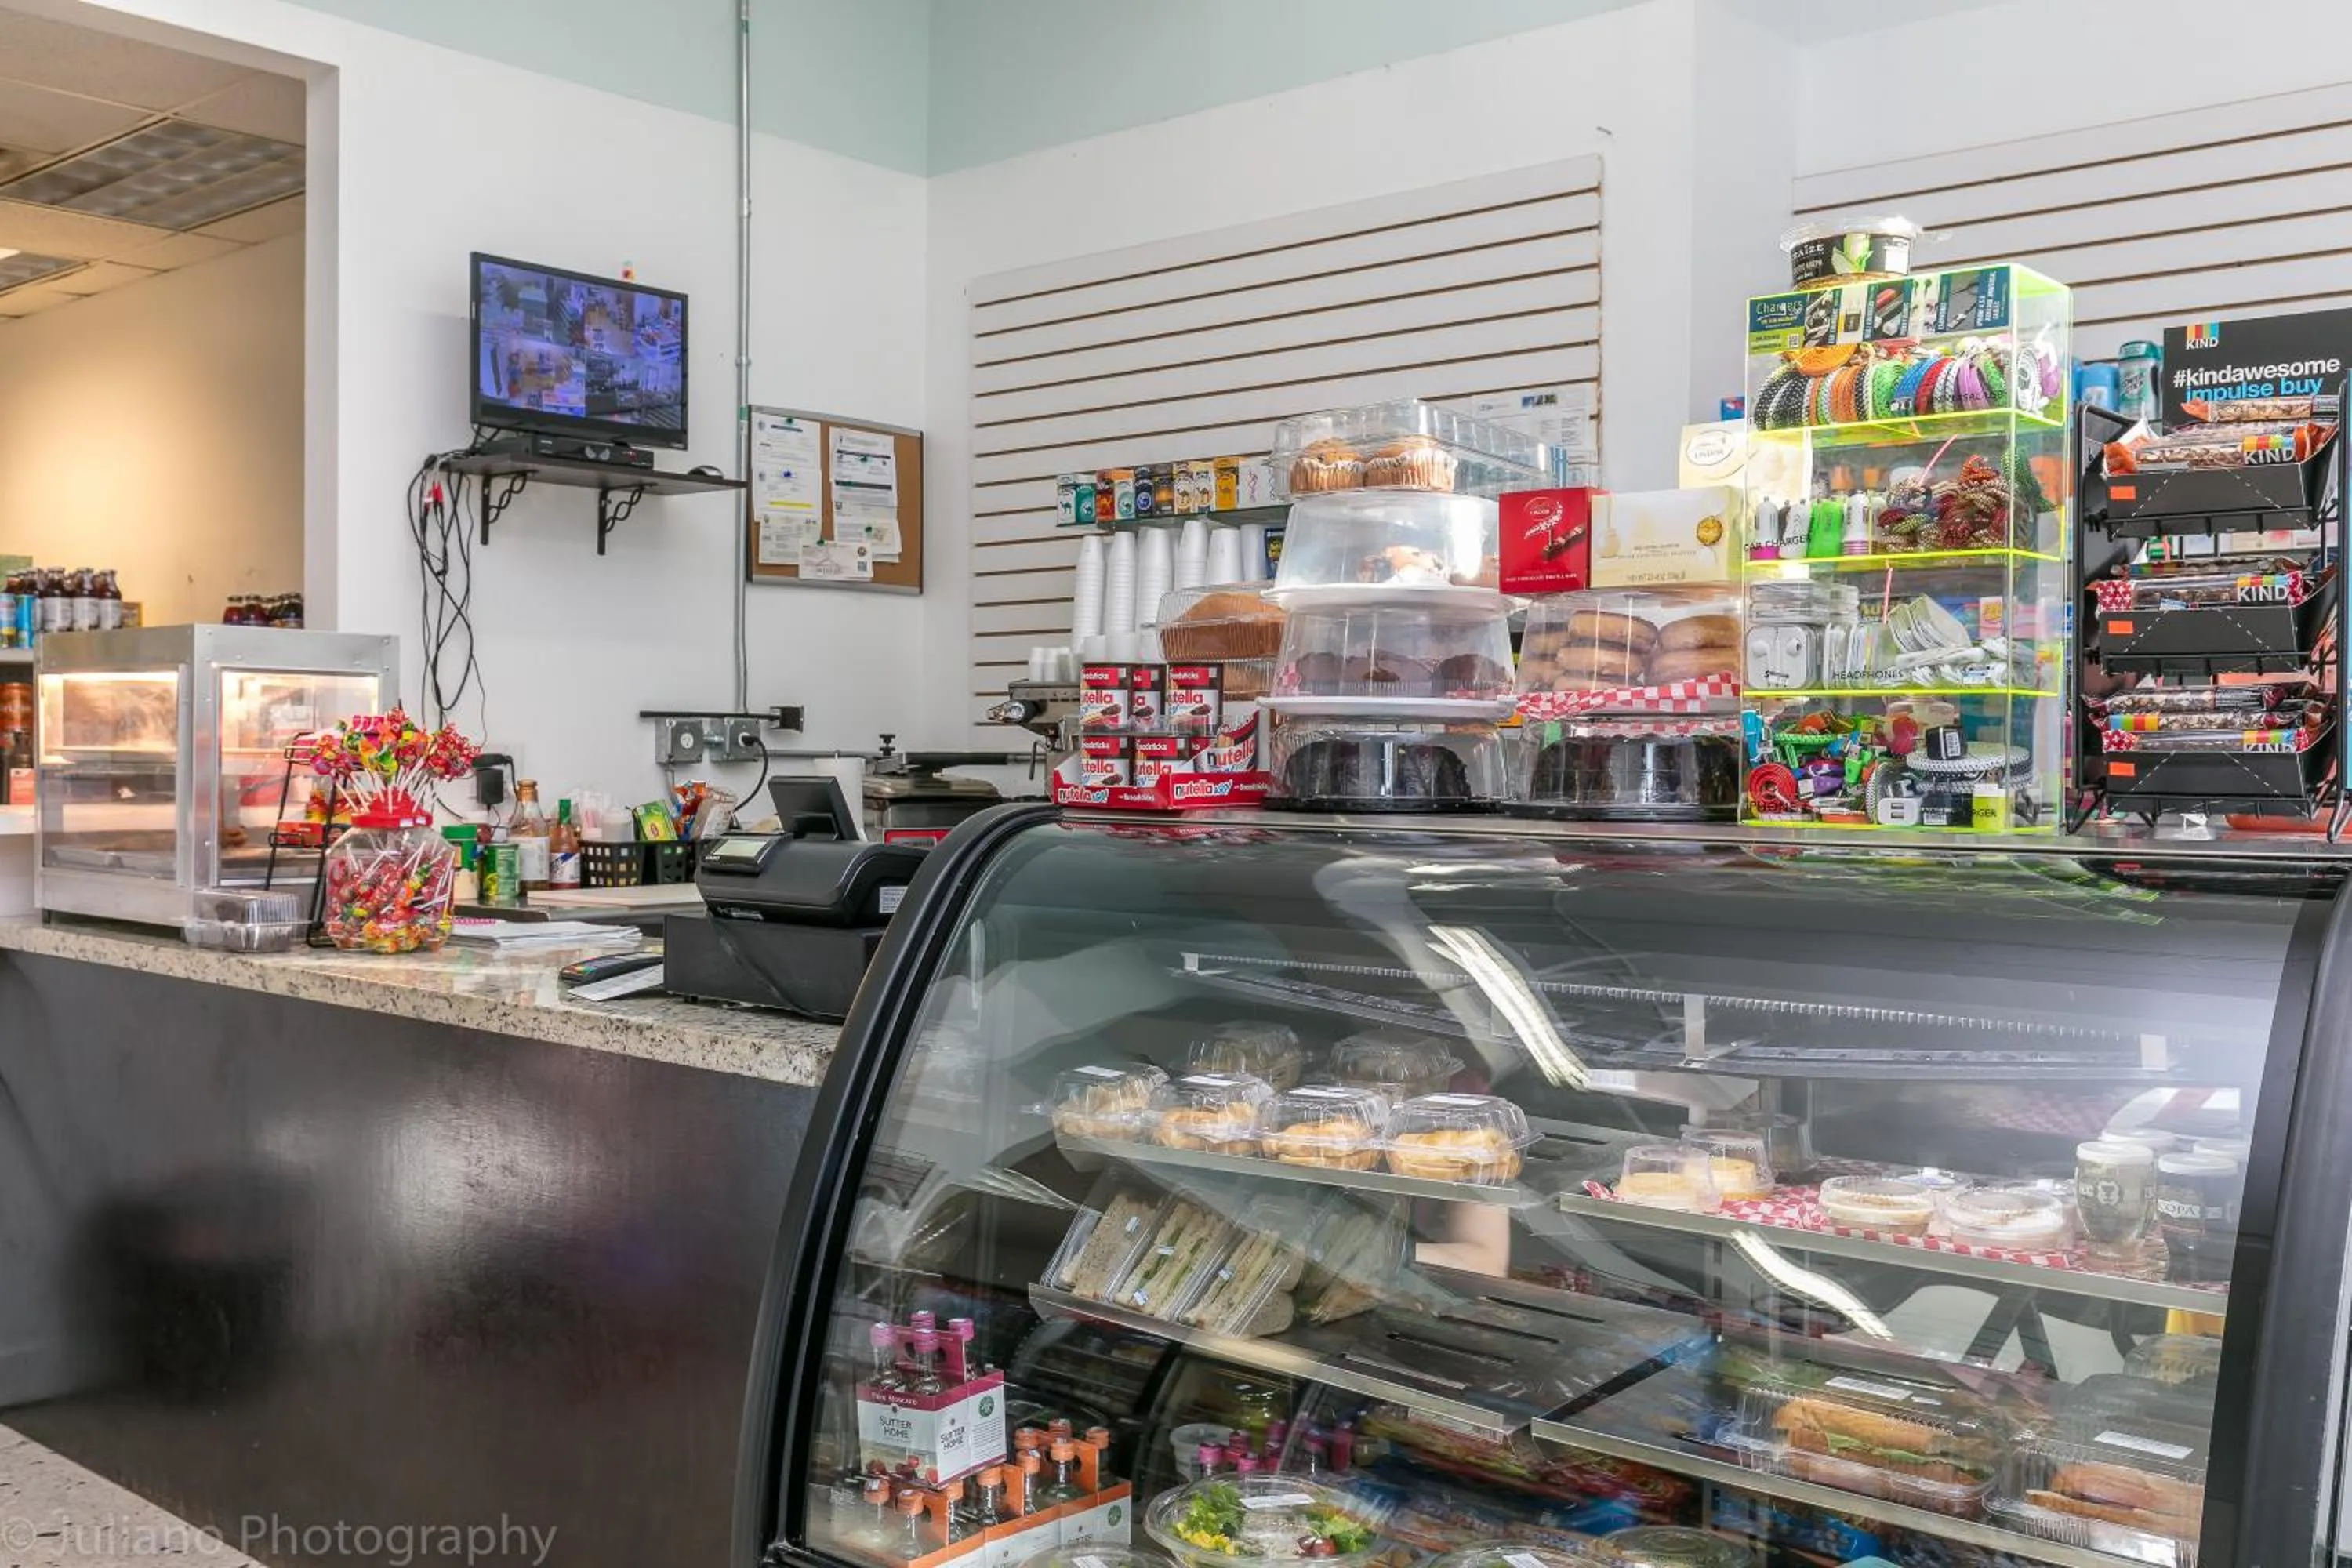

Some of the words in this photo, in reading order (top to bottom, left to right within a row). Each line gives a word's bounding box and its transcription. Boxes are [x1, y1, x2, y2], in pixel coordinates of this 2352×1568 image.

[2185, 337, 2219, 350] KIND
[2173, 358, 2341, 388] #kindawesome
[2186, 381, 2274, 403] impulse
[2280, 376, 2324, 395] buy
[2245, 448, 2295, 465] KIND
[2237, 586, 2288, 602] KIND
[879, 1416, 912, 1430] SUTTER
[884, 1426, 909, 1439] HOME
